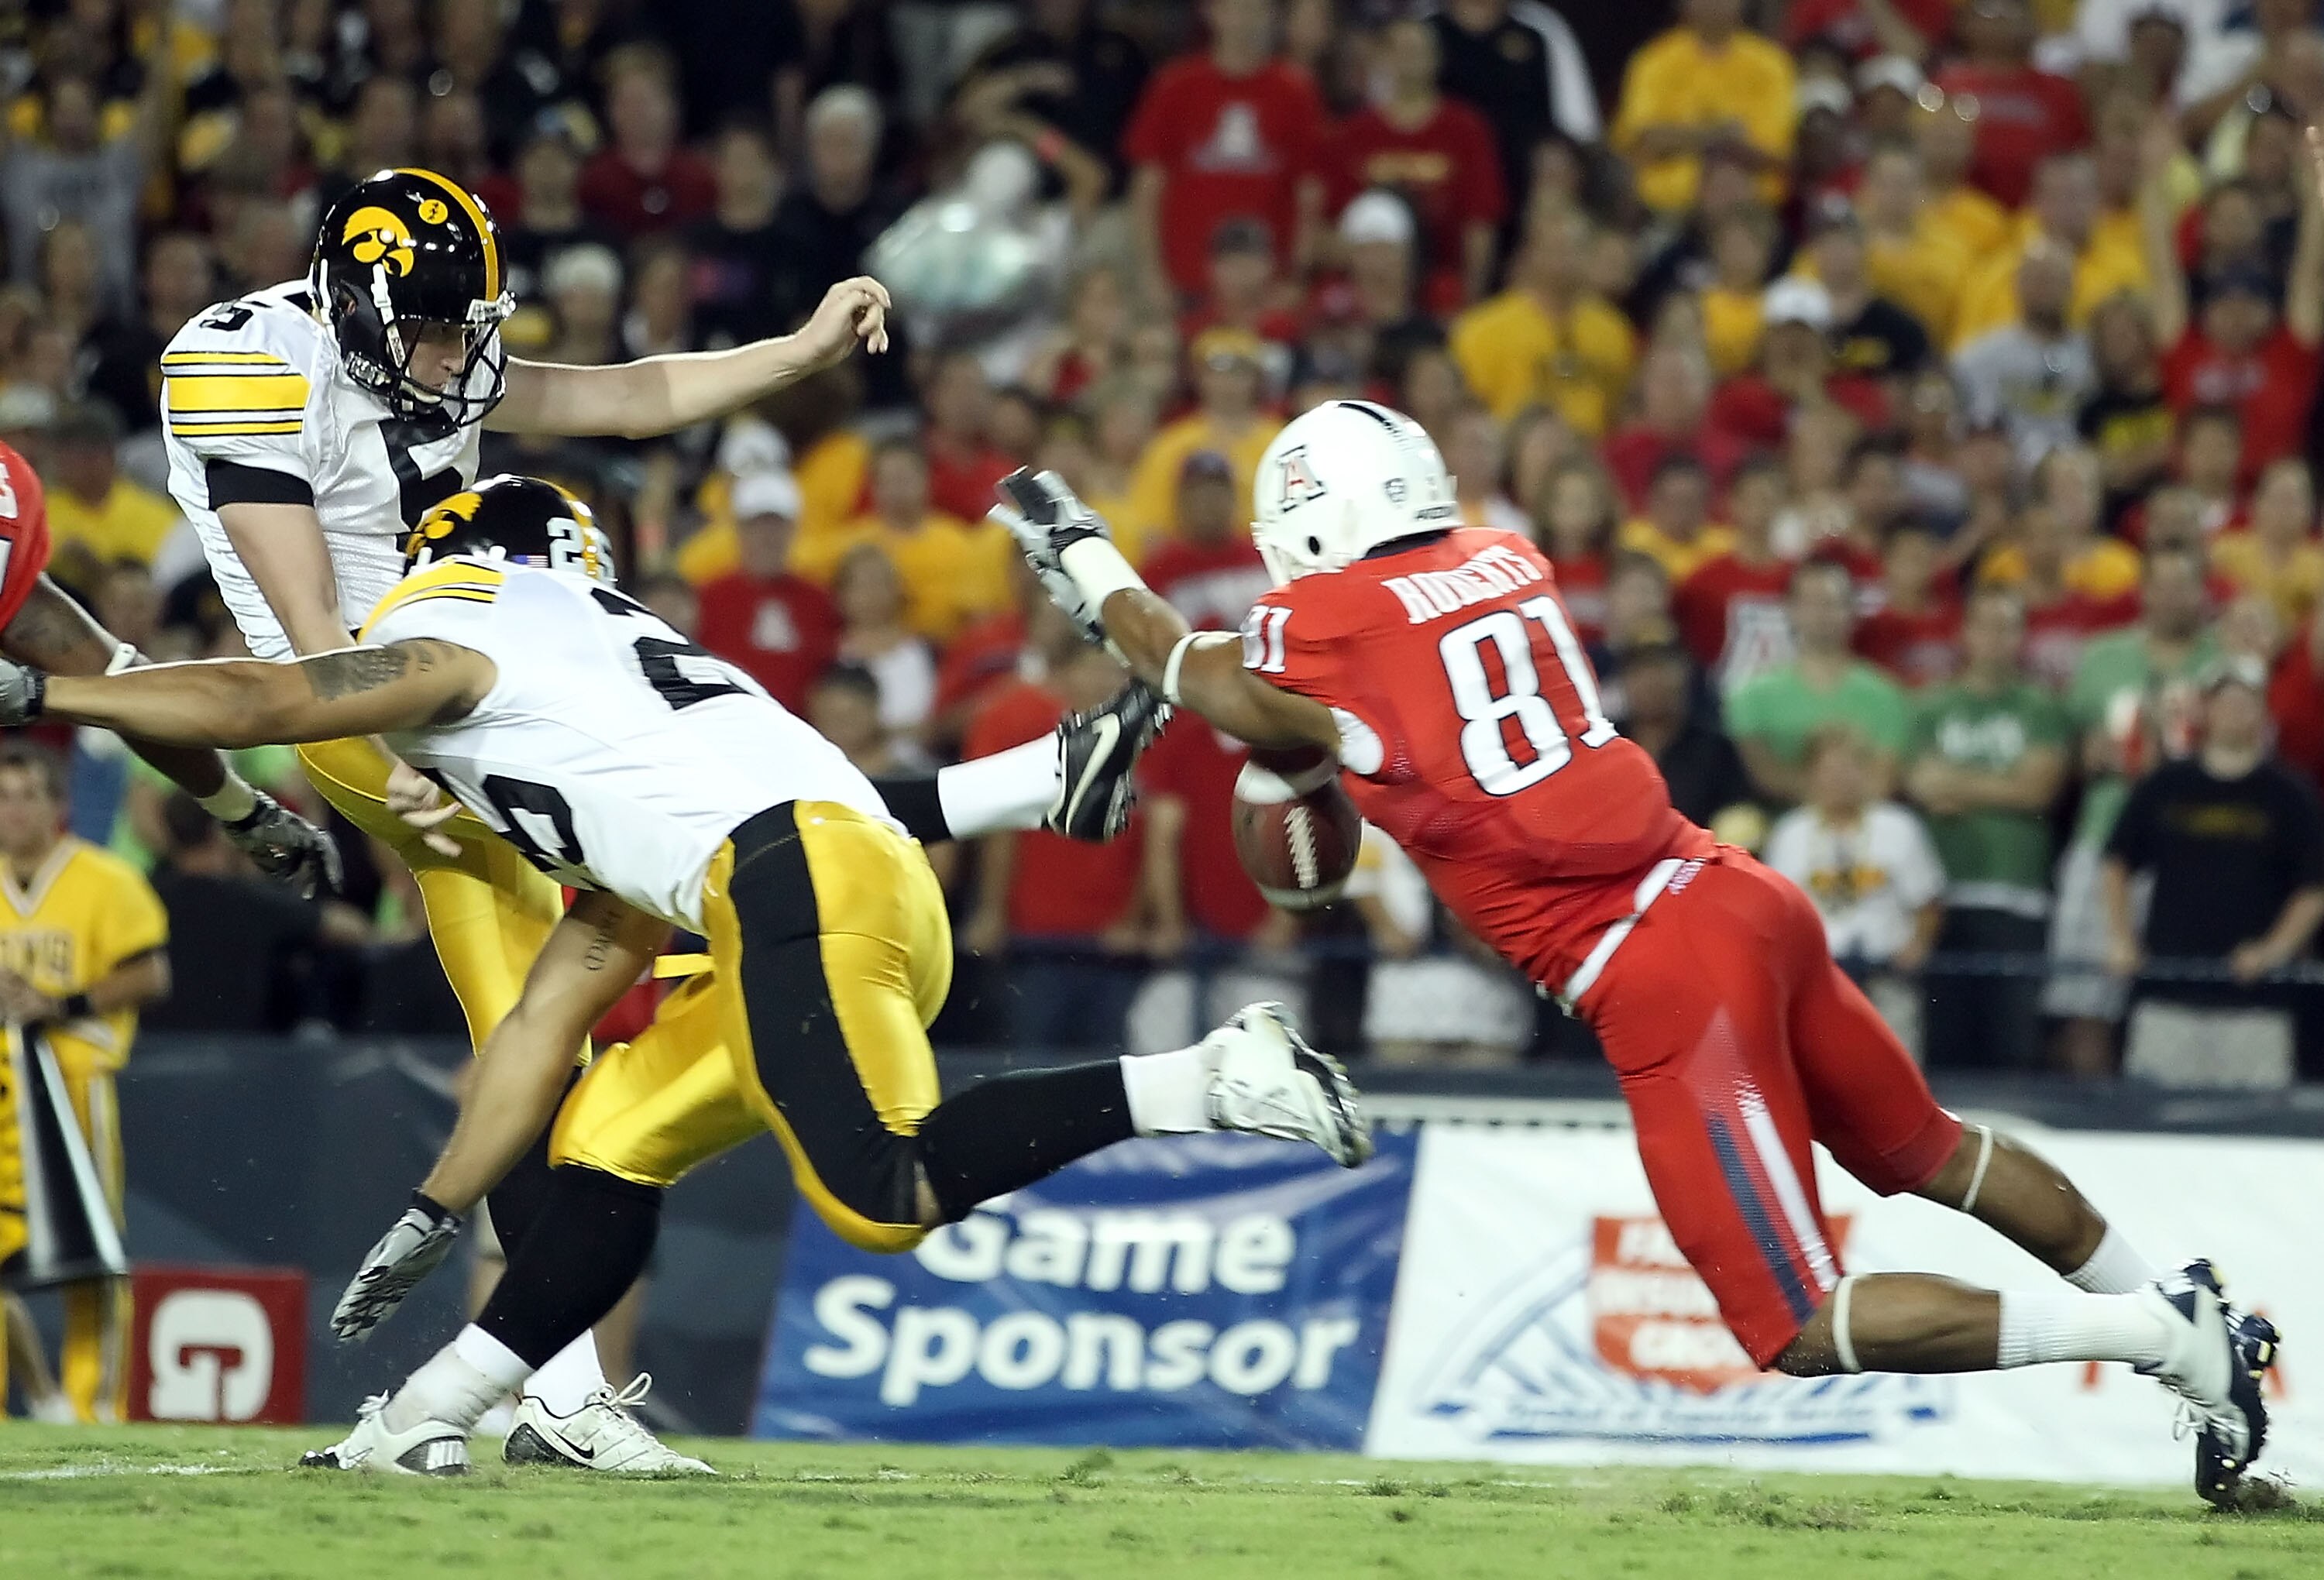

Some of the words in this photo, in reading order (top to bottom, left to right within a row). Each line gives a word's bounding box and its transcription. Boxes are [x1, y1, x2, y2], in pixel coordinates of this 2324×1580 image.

[1277, 444, 1328, 513] A
[1381, 544, 1544, 624] ROBERTS
[1438, 594, 1620, 797] 81
[914, 1207, 1298, 1296] Game
[147, 1289, 275, 1422] G
[803, 1274, 1361, 1407] Sponsor
